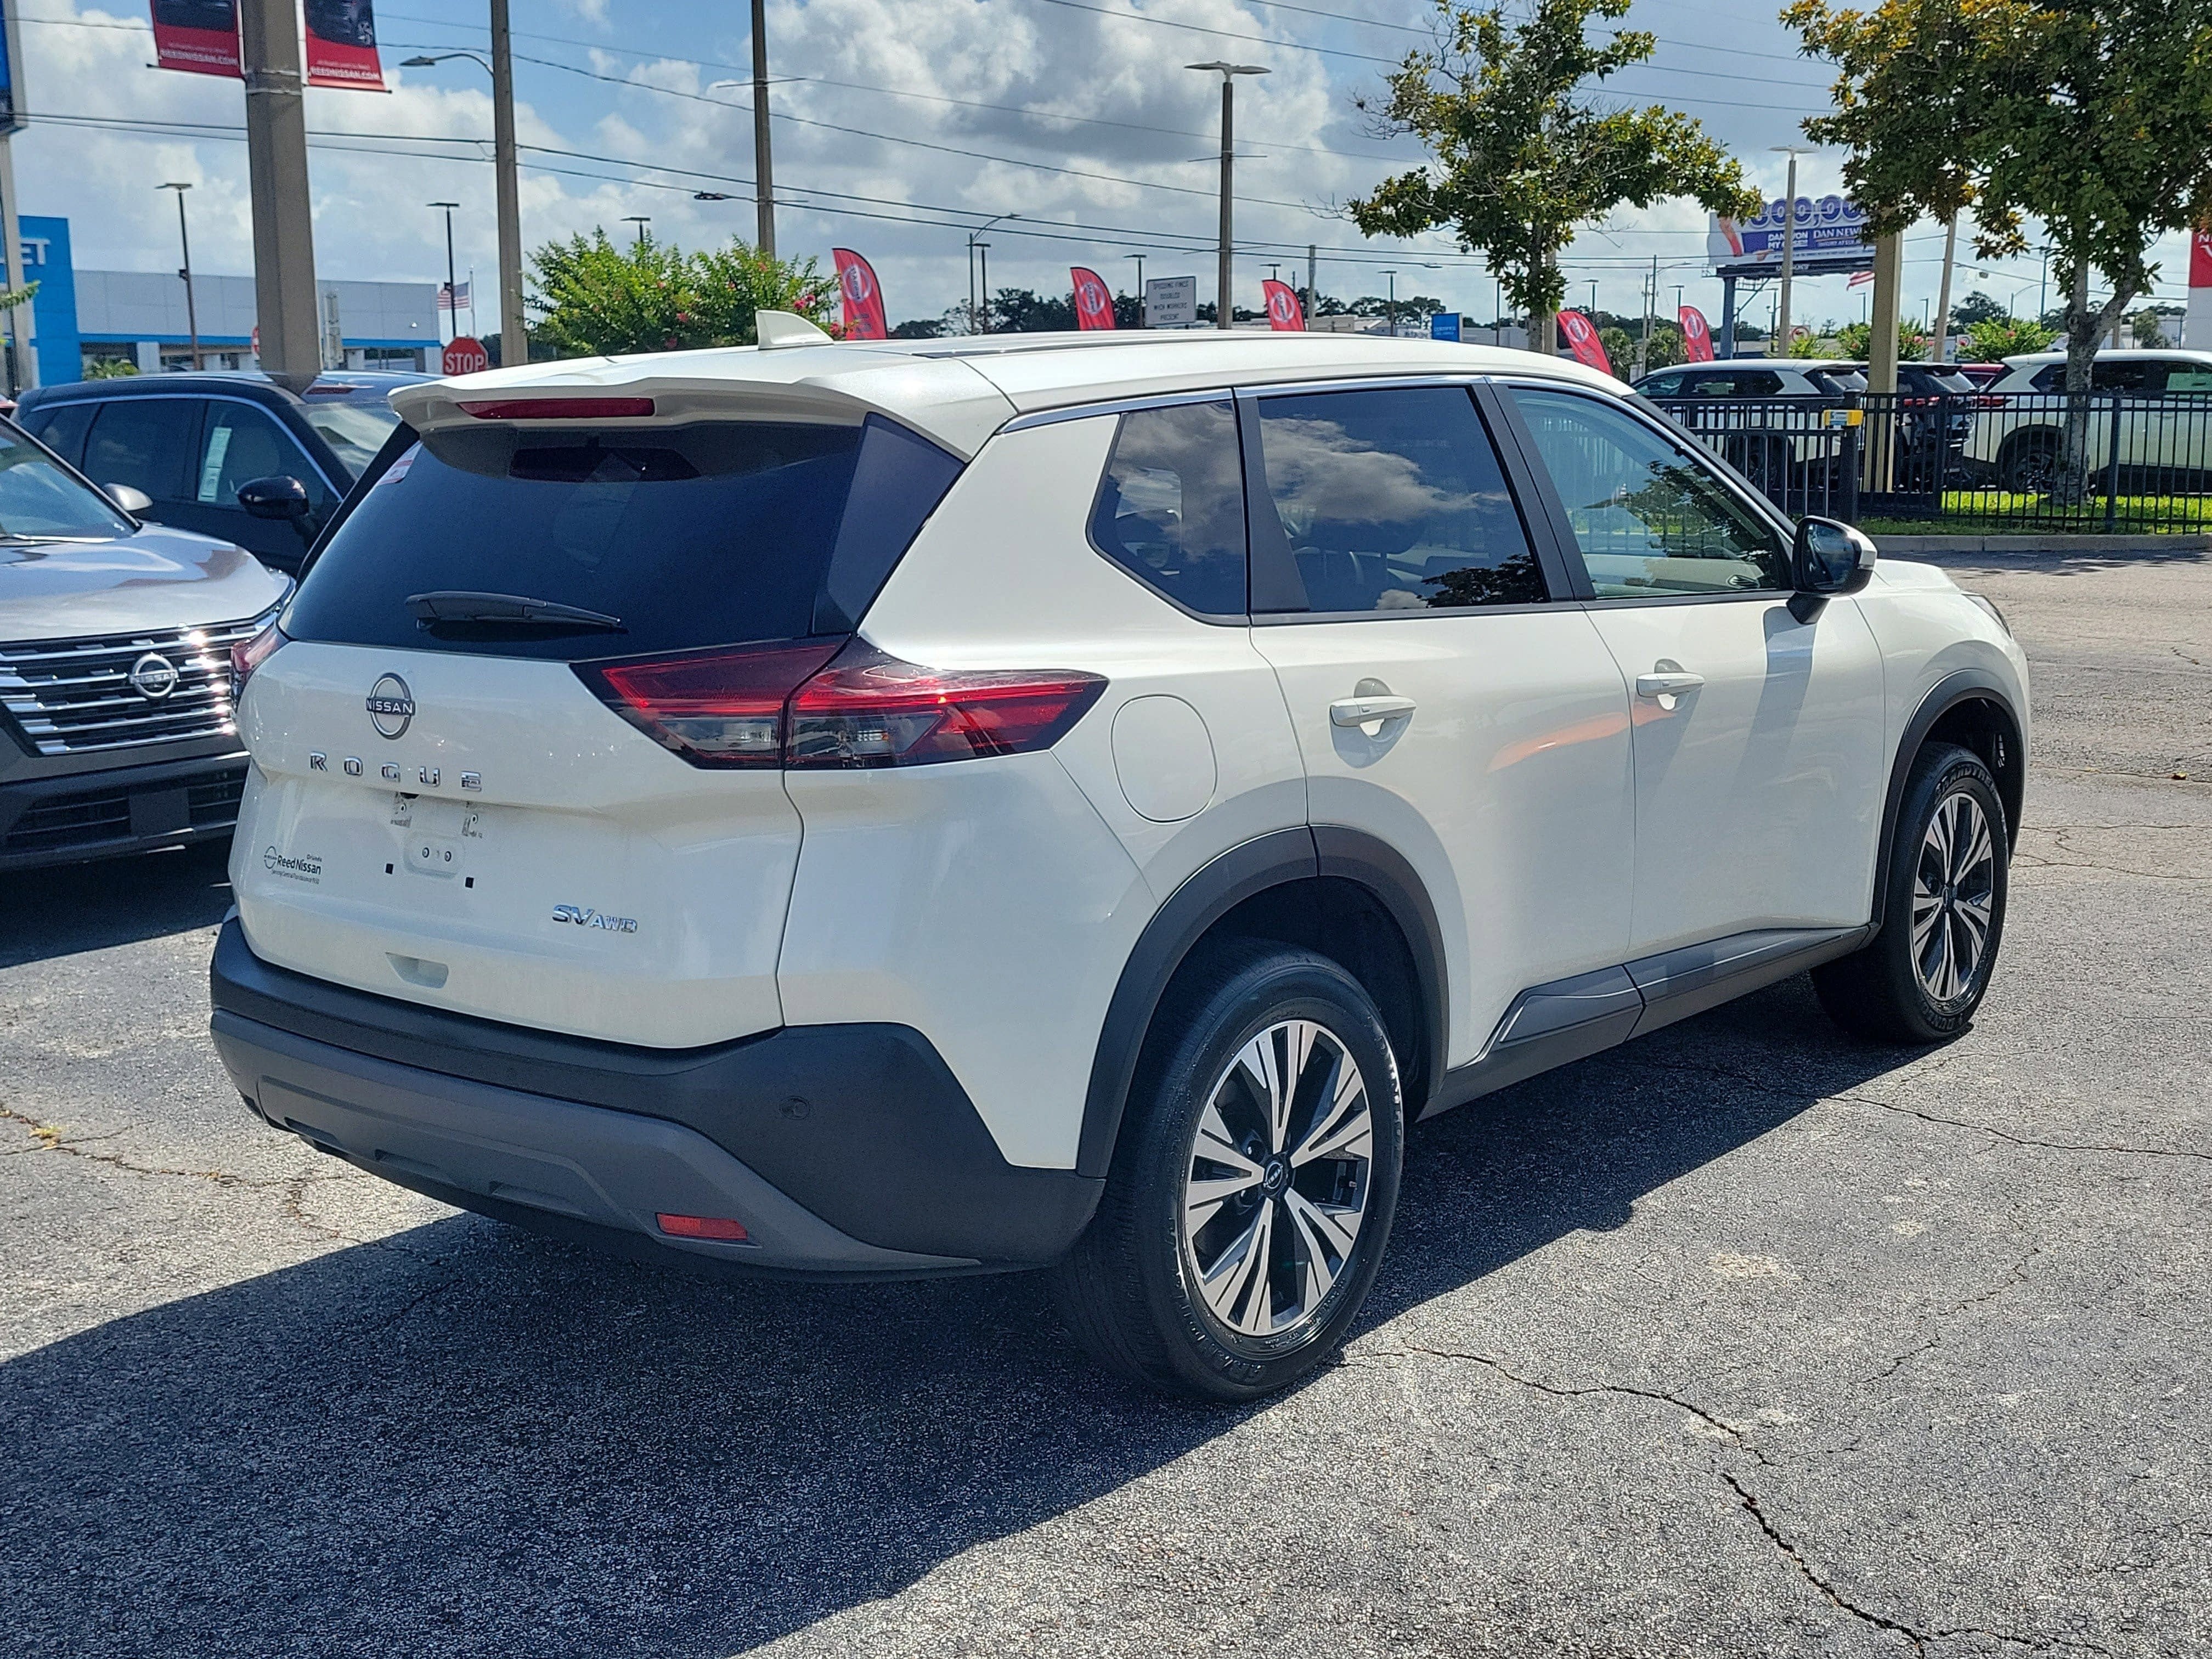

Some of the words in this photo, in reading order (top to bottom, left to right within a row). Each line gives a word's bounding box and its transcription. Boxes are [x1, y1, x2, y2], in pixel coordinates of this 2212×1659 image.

[1813, 229, 1835, 239] DAN
[445, 352, 484, 373] STOP
[366, 699, 413, 714] NISSAN
[309, 752, 482, 792] ROGUE
[552, 904, 595, 926] SV
[589, 915, 638, 933] AWD
